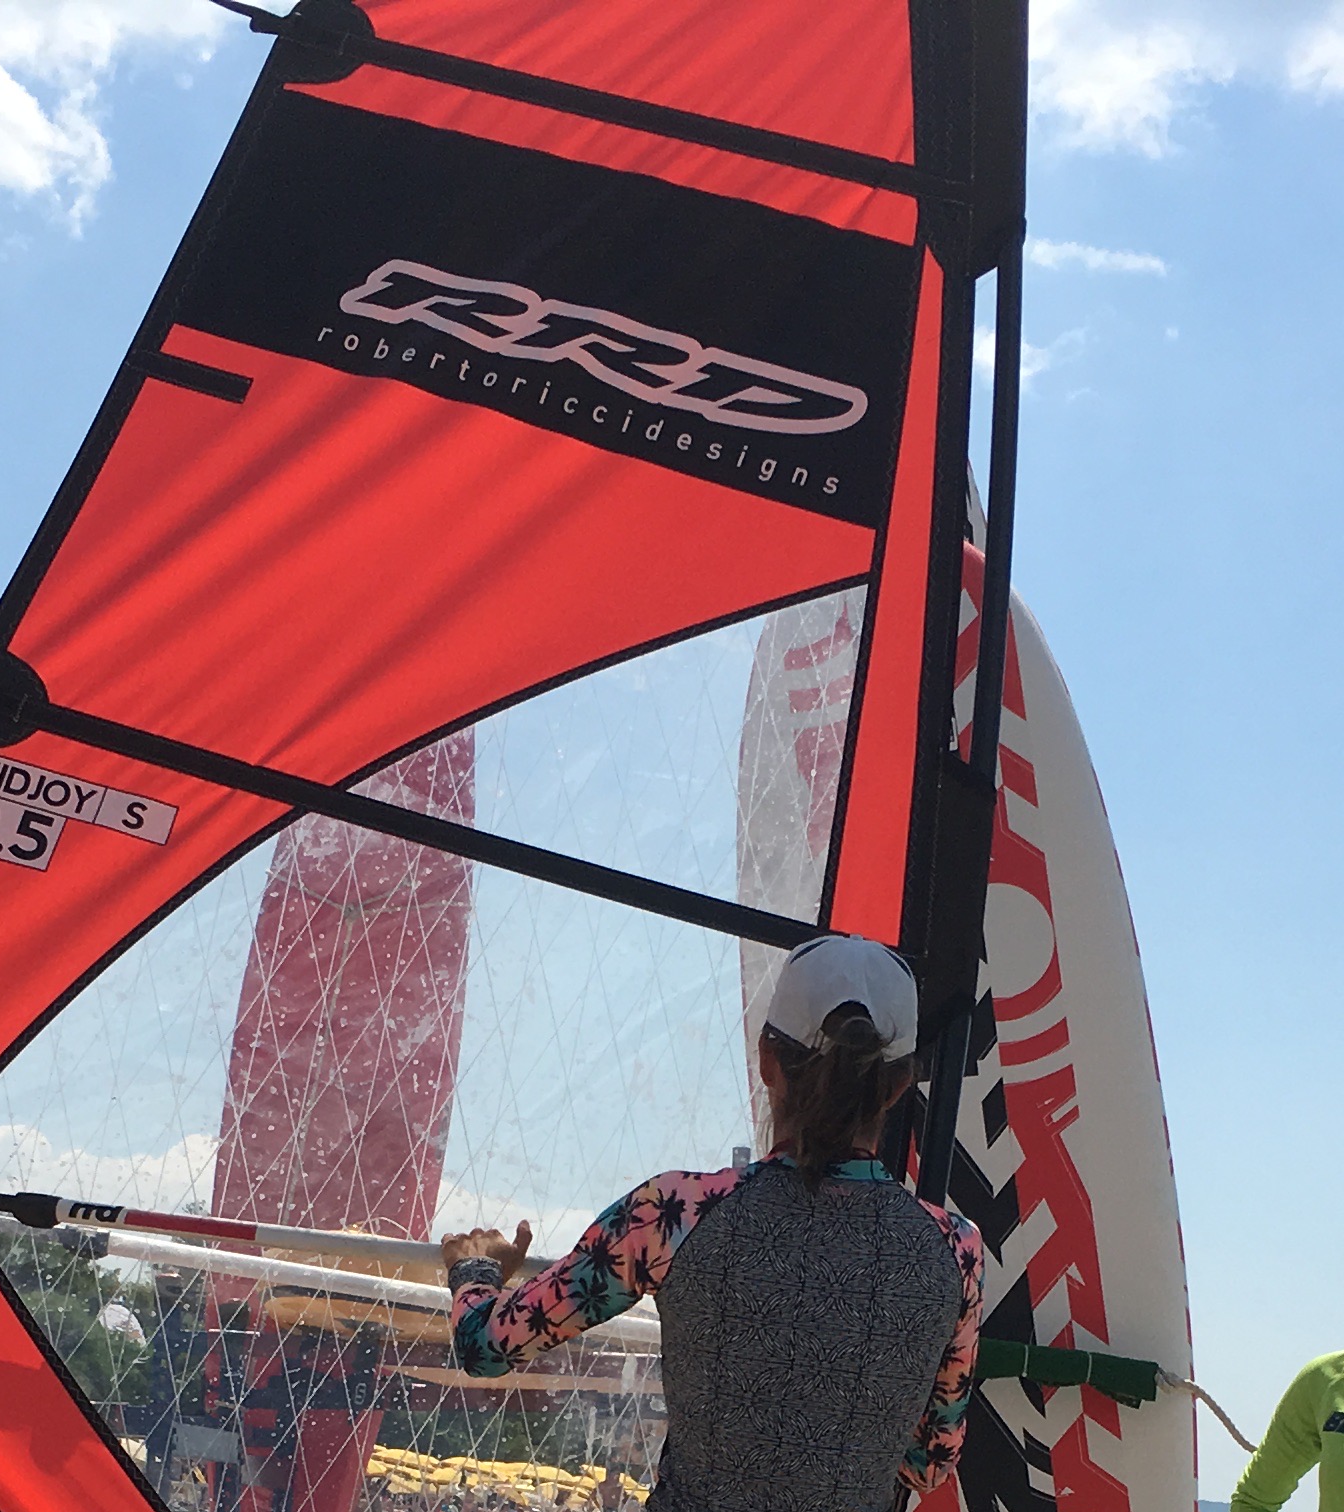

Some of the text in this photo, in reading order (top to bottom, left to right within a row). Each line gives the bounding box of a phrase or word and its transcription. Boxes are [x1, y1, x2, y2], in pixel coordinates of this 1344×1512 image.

[316, 324, 840, 495] robertoriccidesigns
[339, 259, 868, 434] RRD
[121, 801, 148, 830] S
